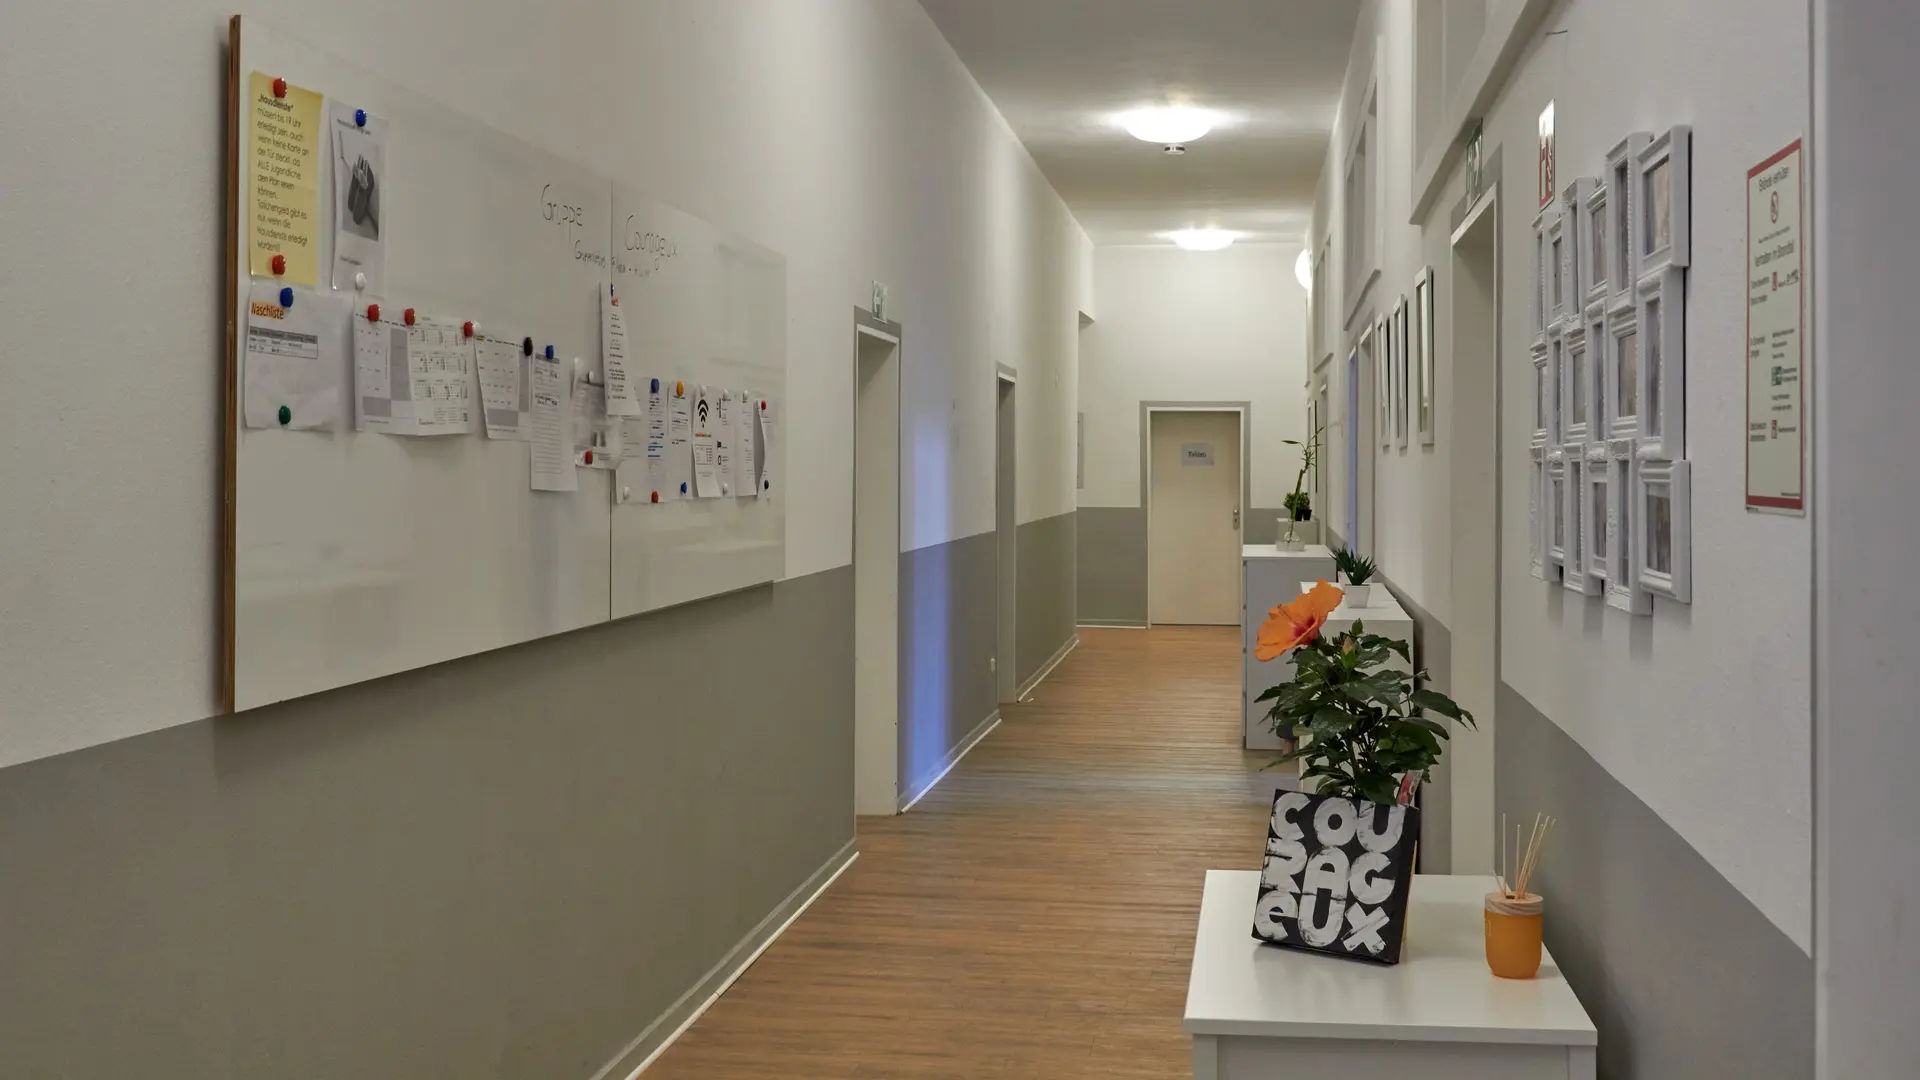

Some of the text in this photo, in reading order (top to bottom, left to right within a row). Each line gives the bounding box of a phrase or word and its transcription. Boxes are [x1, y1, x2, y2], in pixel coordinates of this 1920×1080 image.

[257, 121, 277, 135] erledigt
[273, 136, 286, 150] keine
[257, 159, 269, 170] ALLE
[252, 302, 284, 320] Naschliste
[1271, 792, 1406, 854] COU
[1261, 838, 1396, 905] RAG
